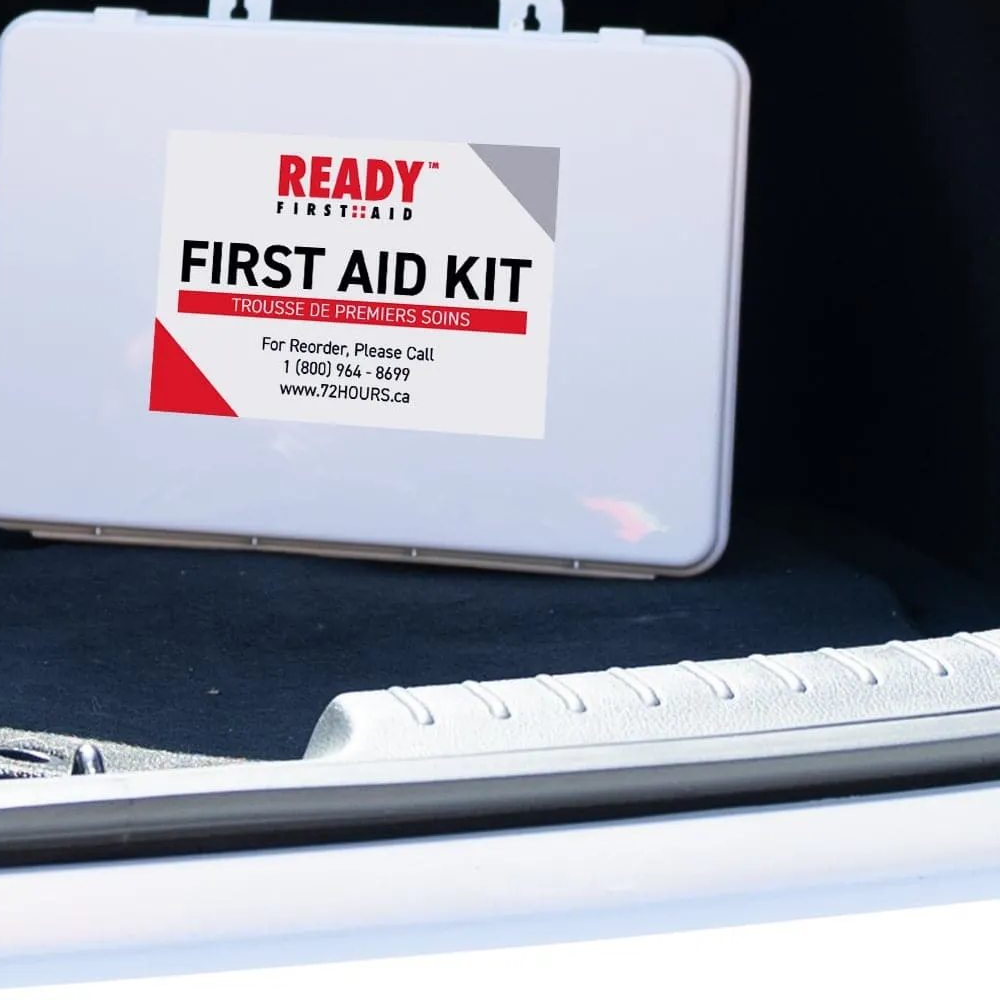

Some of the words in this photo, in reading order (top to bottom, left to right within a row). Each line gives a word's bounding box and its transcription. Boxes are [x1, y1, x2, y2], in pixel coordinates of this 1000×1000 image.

[278, 154, 424, 203] READY
[181, 240, 325, 290] FIRST
[338, 250, 426, 296] AID
[446, 255, 532, 302] KIT
[232, 298, 304, 316] TROUSSE
[309, 303, 330, 318] DE
[335, 304, 417, 324] PREMIERS
[421, 310, 470, 327] SOINS
[262, 337, 286, 352] For
[290, 339, 350, 357] Reorder,
[354, 343, 402, 360] Please
[407, 346, 434, 361] Call
[283, 360, 289, 373] 1
[295, 360, 331, 378] (800)
[336, 363, 361, 378] 964
[376, 365, 410, 381] 8699
[280, 384, 410, 403] www.72HOURS.ca
